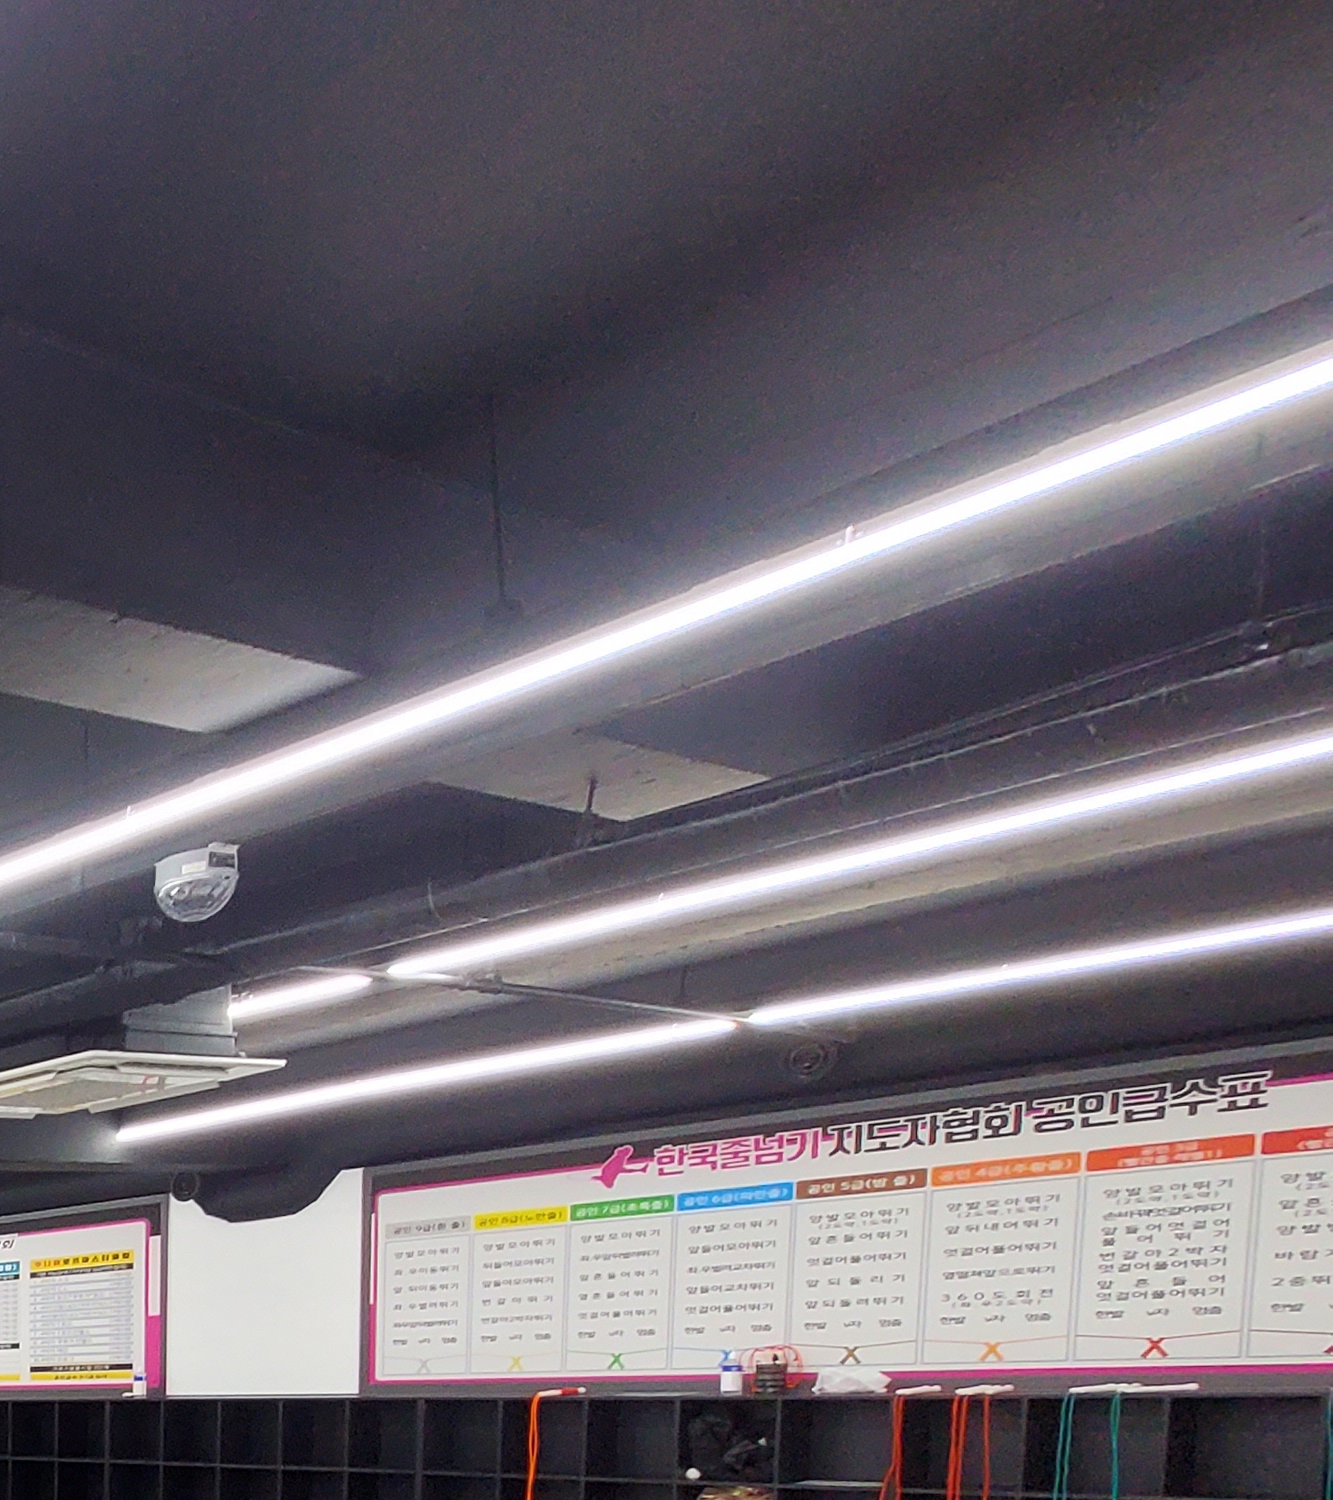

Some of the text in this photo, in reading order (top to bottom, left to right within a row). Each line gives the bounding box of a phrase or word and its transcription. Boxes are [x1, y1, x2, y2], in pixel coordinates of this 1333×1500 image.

[1032, 1071, 1272, 1134] 공인급수표
[939, 1168, 971, 1183] 공인
[807, 1180, 835, 1195] 공인
[684, 1194, 709, 1208] 공인
[575, 1205, 598, 1218] 공인
